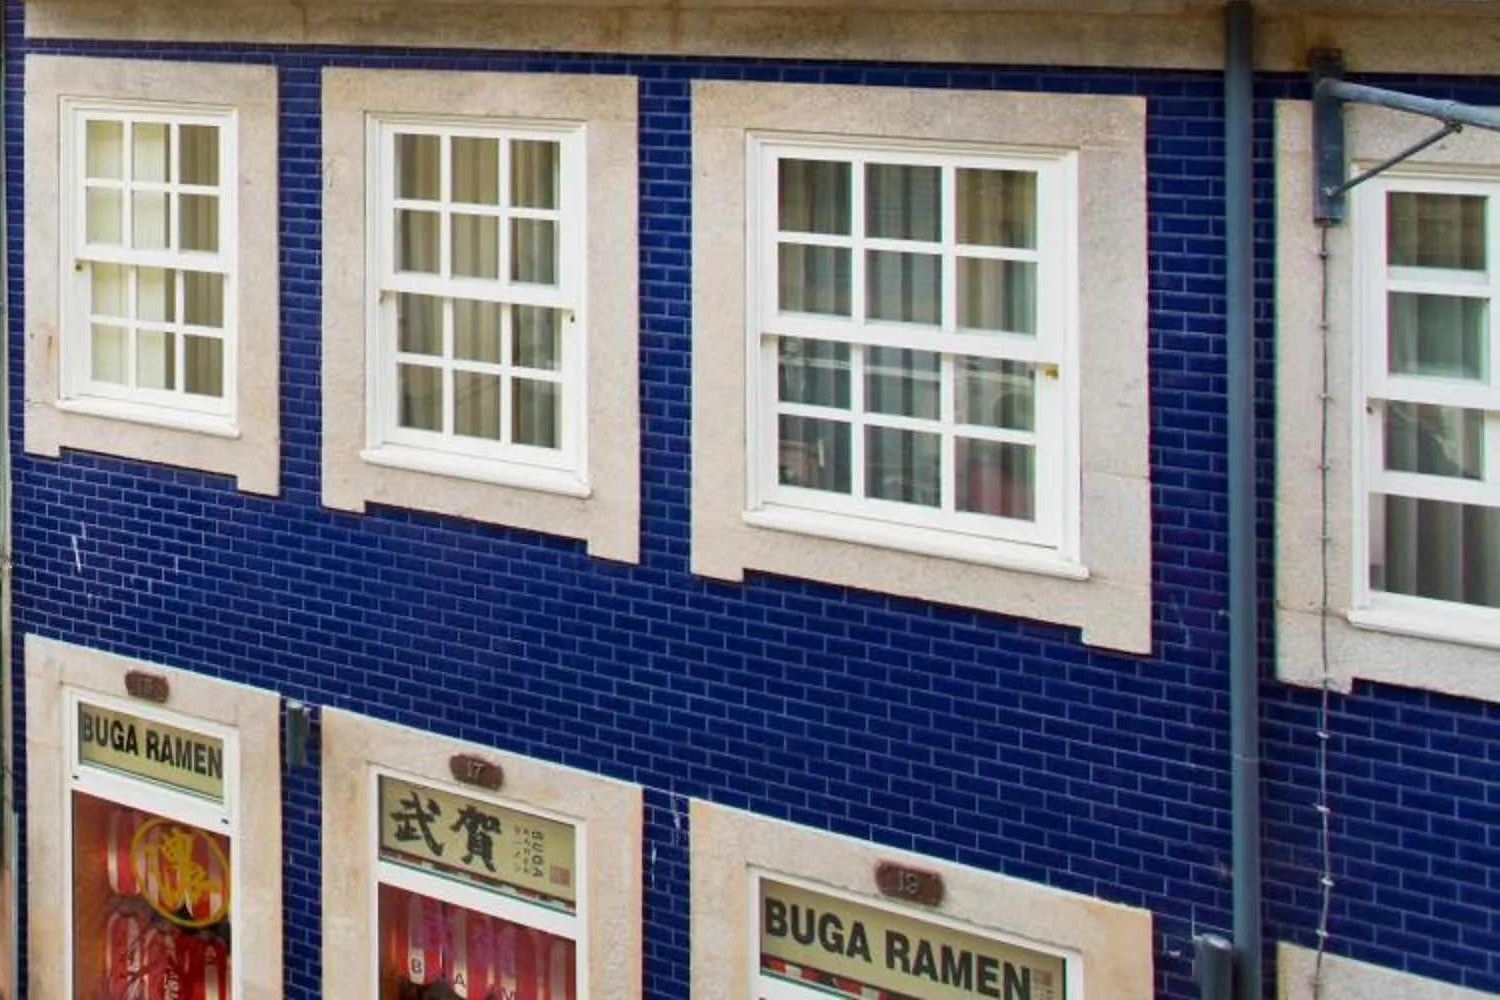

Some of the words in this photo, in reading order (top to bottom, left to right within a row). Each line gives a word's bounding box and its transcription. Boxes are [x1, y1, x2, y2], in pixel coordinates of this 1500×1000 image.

[83, 711, 140, 756] BUGA
[145, 727, 223, 779] RAMEN
[764, 897, 872, 963] BUGA
[885, 929, 1032, 1000] RAMEN
